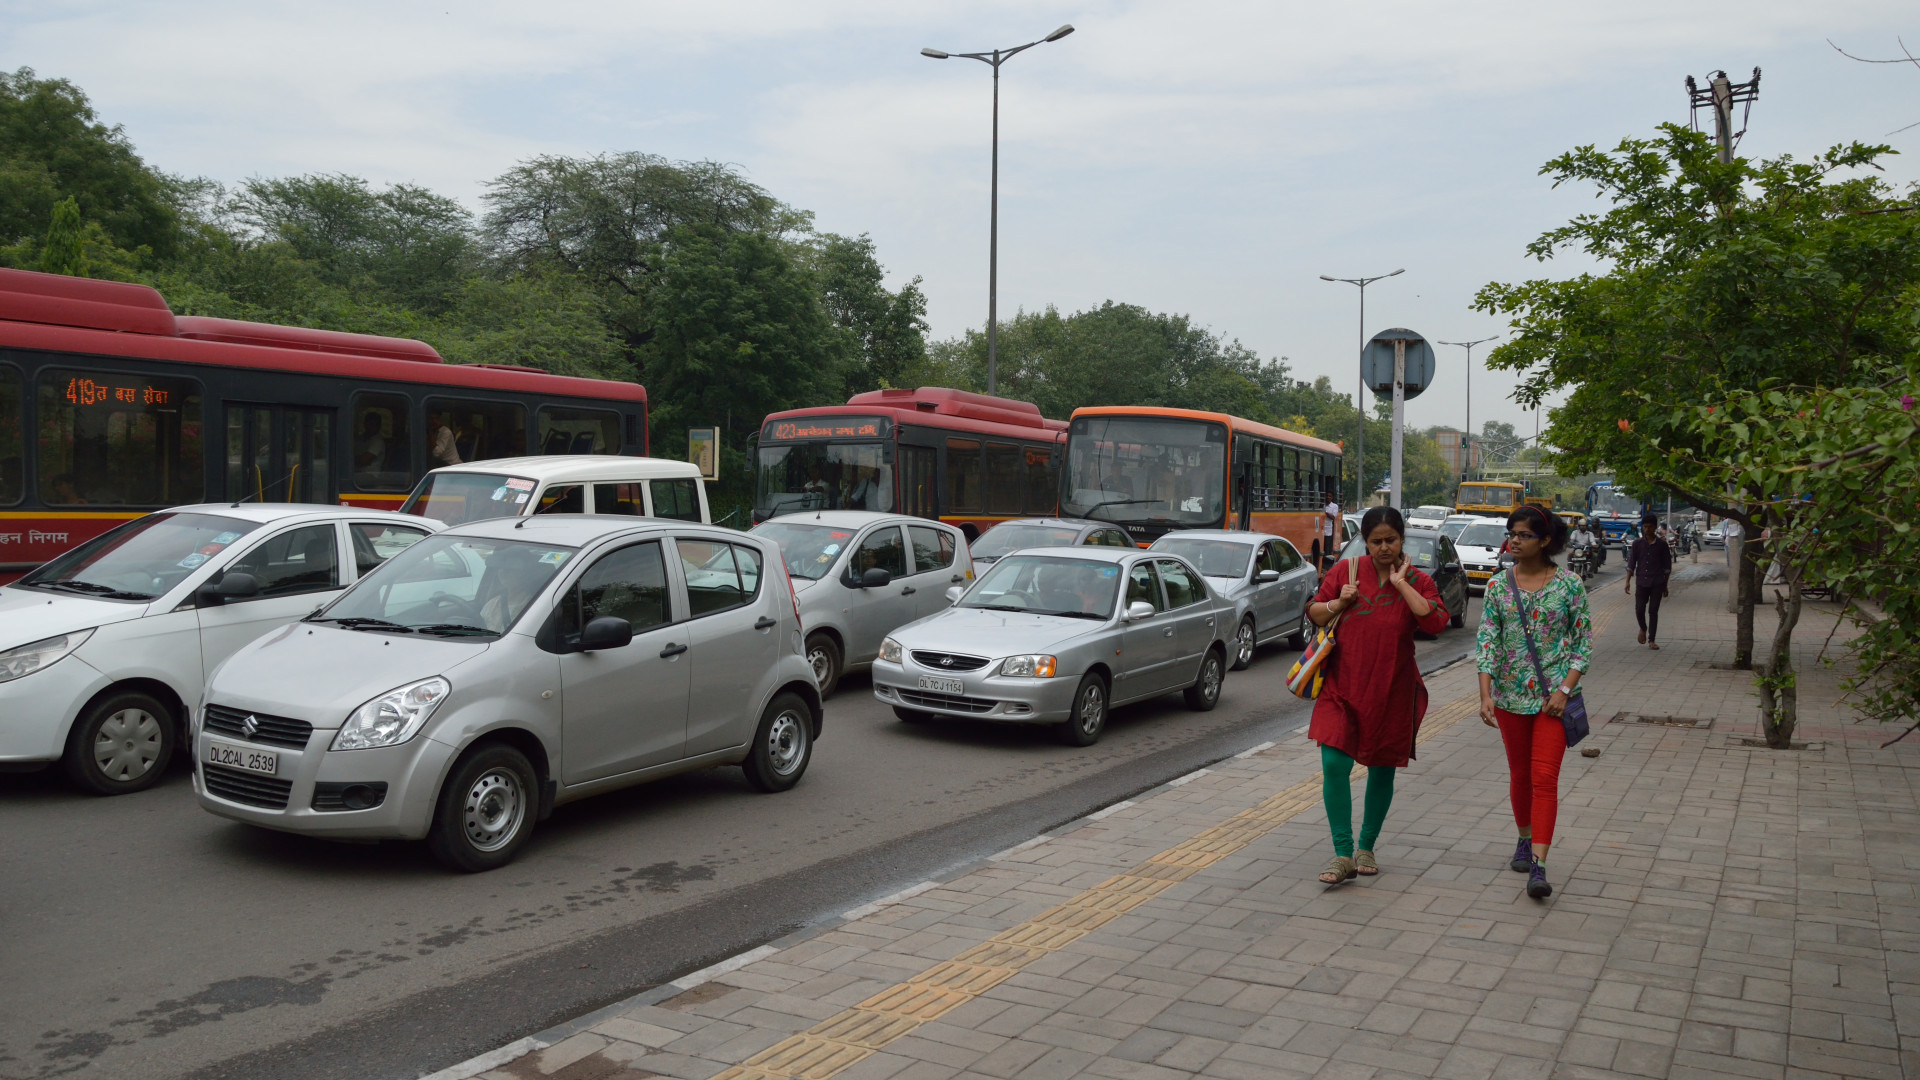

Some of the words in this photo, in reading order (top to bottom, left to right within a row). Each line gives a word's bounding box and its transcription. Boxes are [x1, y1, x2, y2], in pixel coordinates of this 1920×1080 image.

[115, 387, 136, 403] बस
[776, 423, 796, 439] 423
[29, 529, 69, 544] निगम
[945, 682, 961, 692] 1154
[210, 746, 245, 767] DL2CAL
[248, 753, 274, 772] 2539
